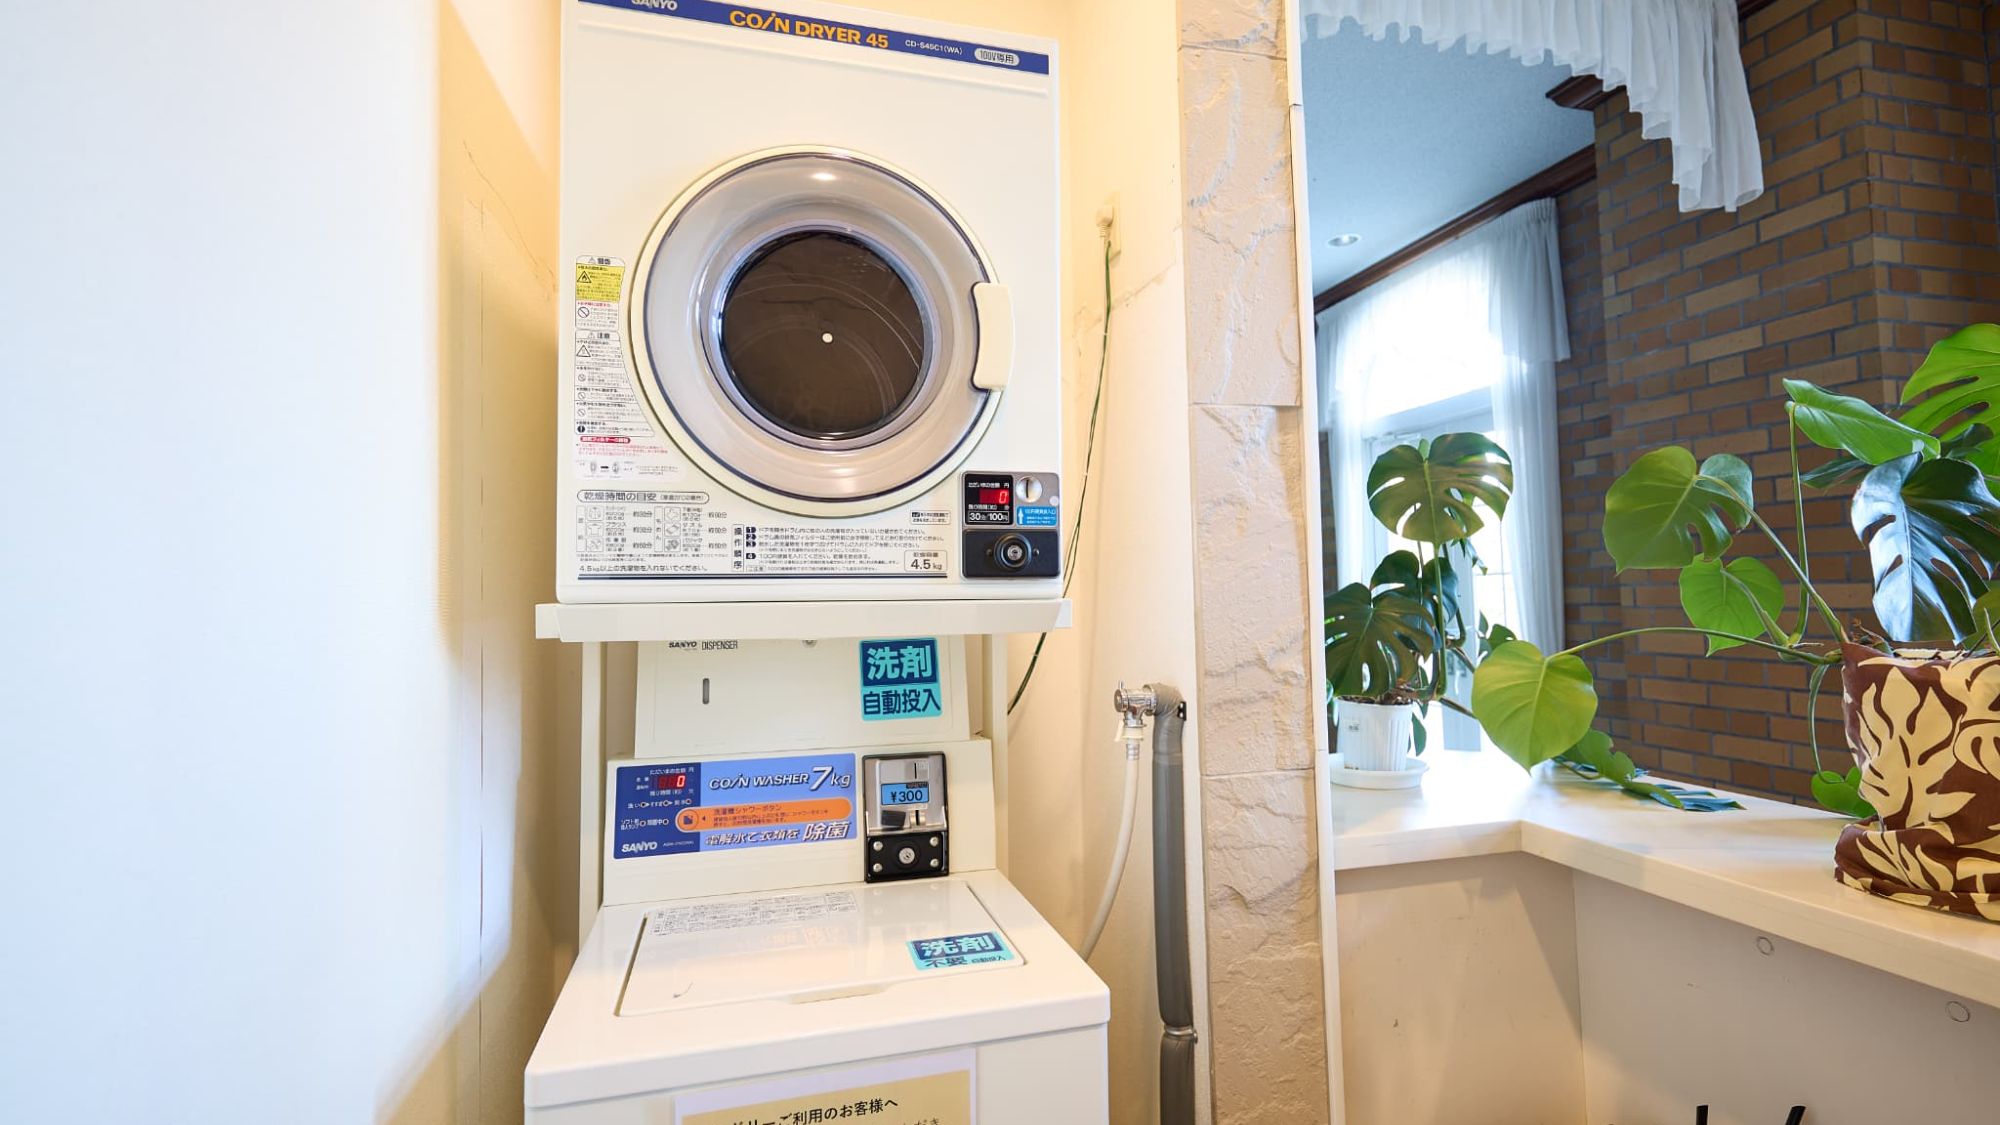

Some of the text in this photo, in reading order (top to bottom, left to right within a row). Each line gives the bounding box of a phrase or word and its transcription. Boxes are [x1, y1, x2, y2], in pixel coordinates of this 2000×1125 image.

[795, 20, 861, 44] DRYER
[866, 32, 888, 48] 45
[584, 491, 657, 501] 乾燥時間の目安
[999, 491, 1008, 504] 0
[911, 559, 931, 570] 4.5
[669, 640, 739, 651] SANYO DISPENSER
[866, 644, 933, 680] 洗剤
[863, 688, 941, 716] 自動投入
[677, 775, 686, 787] 0
[753, 773, 809, 788] WASHER
[891, 789, 923, 803] ¥300
[802, 822, 851, 841] 除菌
[621, 840, 658, 853] SANYO
[920, 934, 996, 956] 洗剤
[924, 956, 968, 968] 不要
